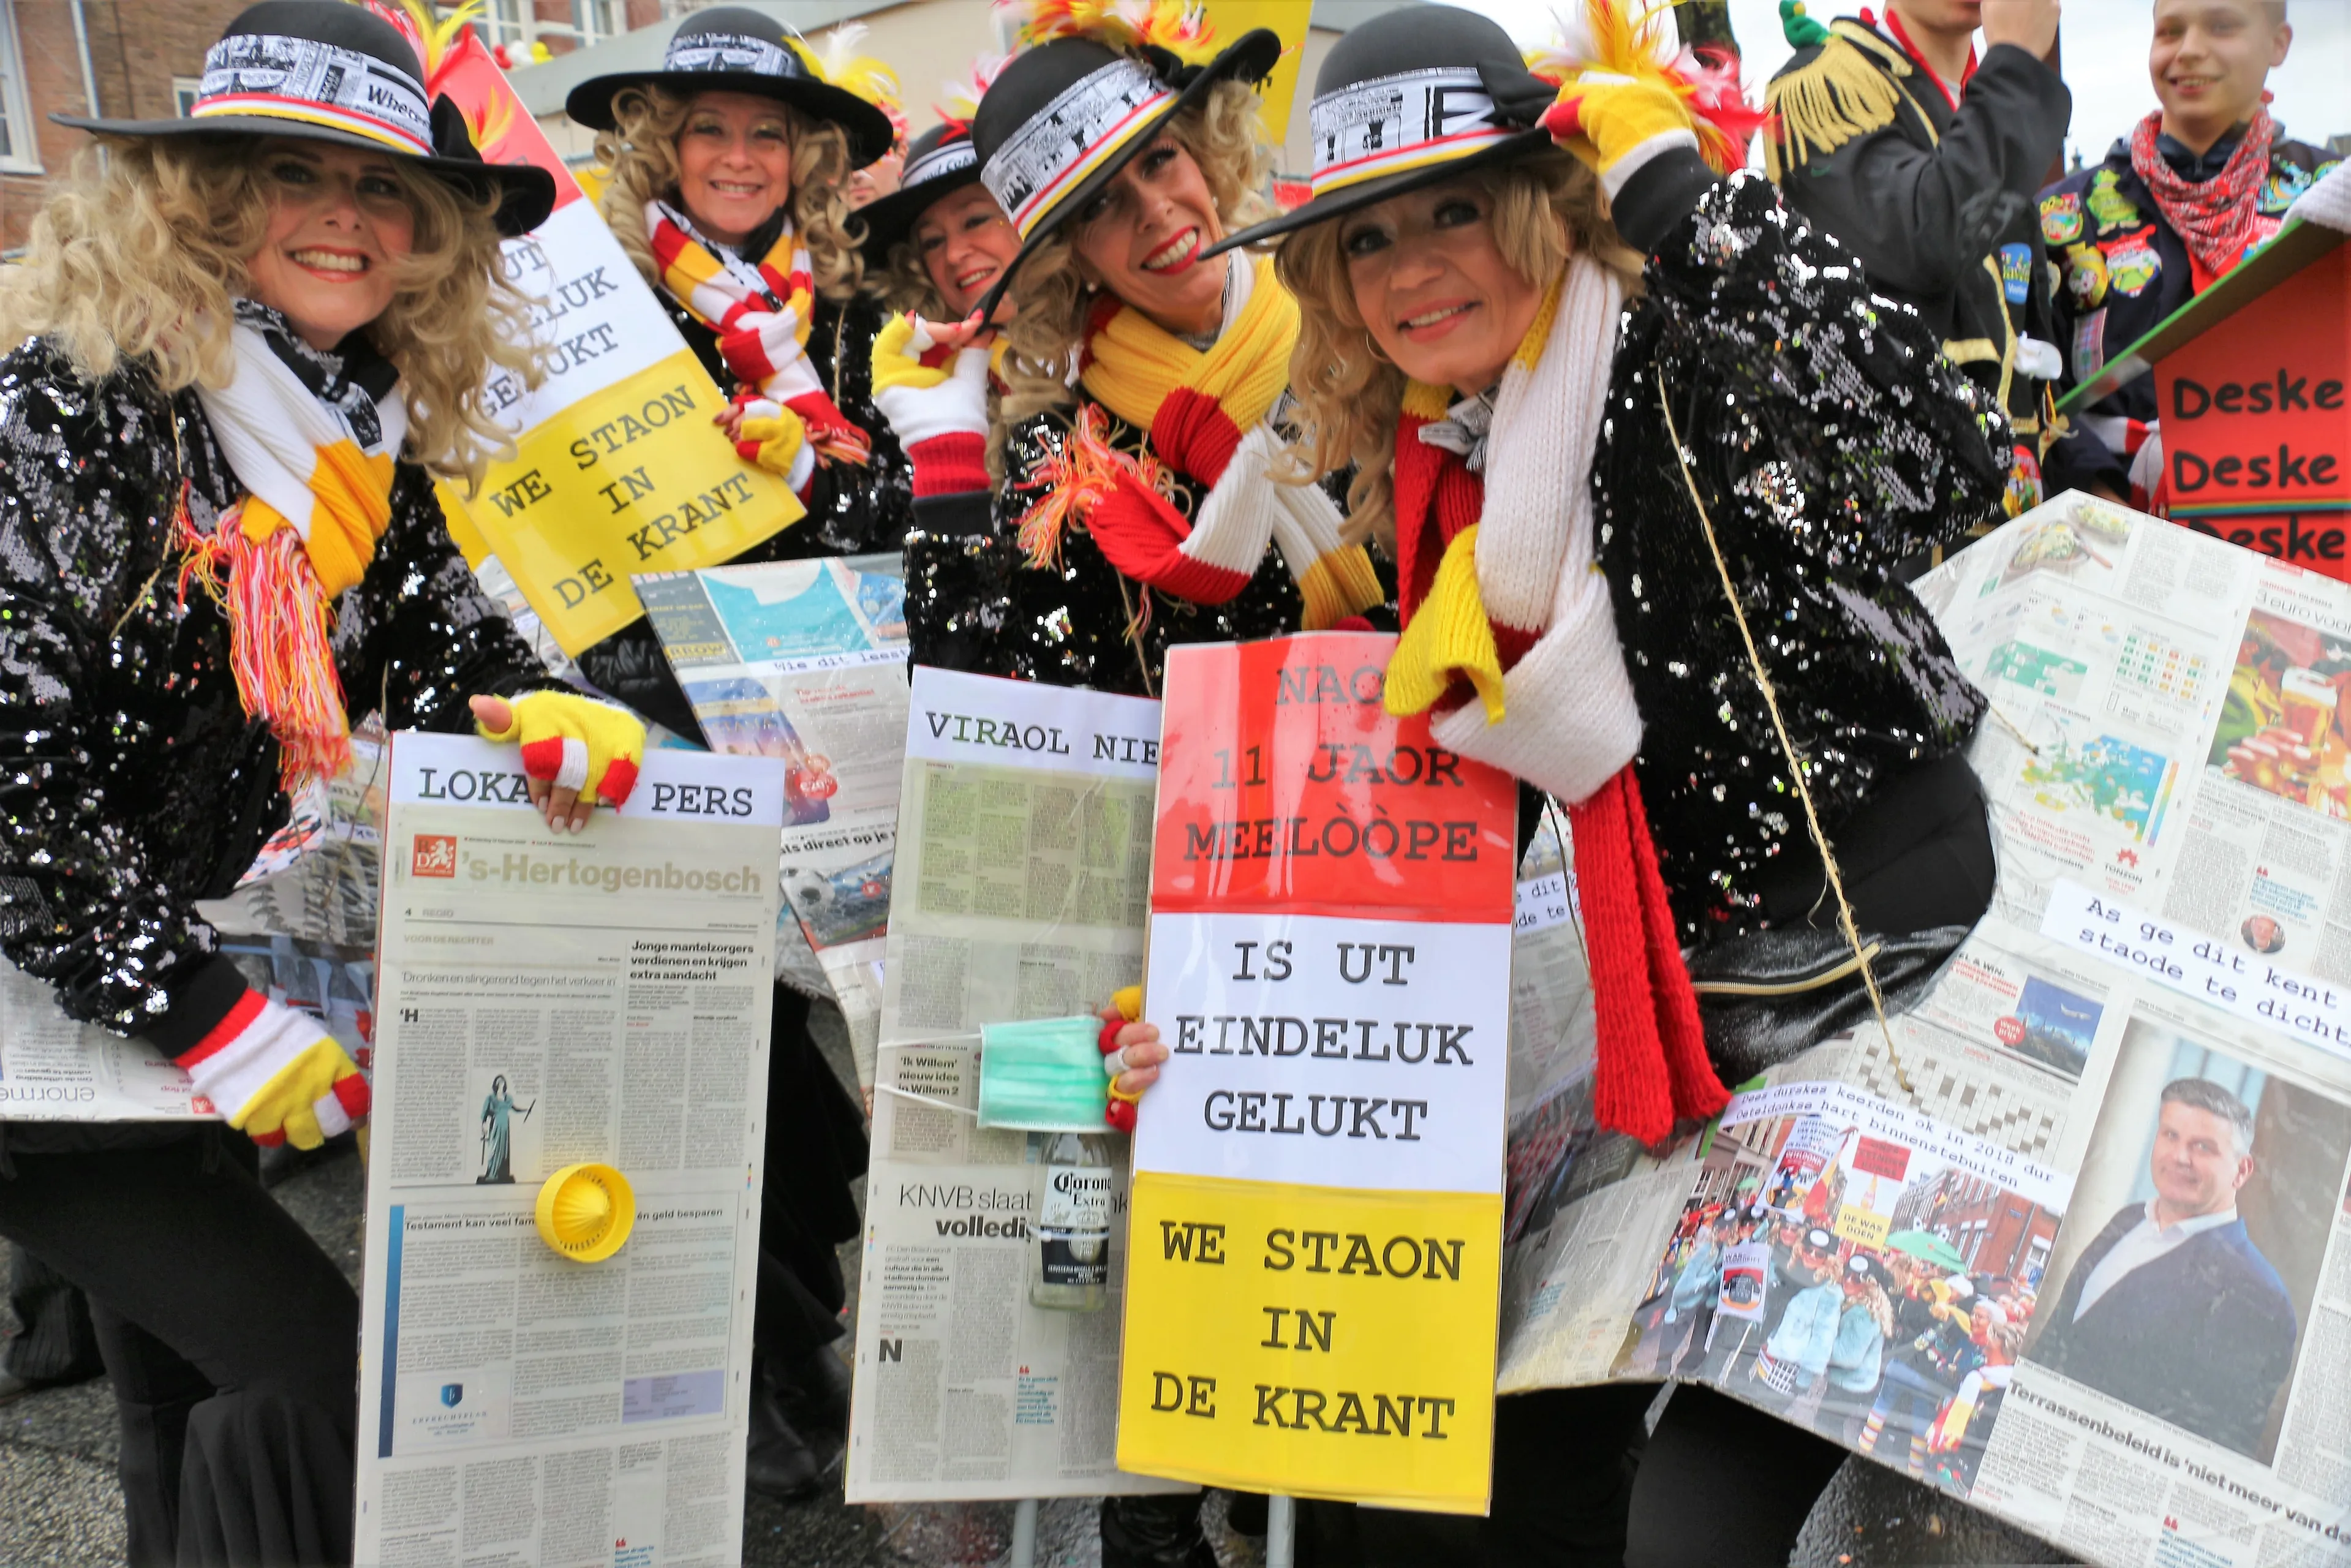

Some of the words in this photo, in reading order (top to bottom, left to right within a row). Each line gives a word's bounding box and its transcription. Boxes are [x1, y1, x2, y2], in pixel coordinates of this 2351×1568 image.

[480, 322, 619, 418] GEUKT
[2173, 369, 2344, 420] Deske
[489, 469, 553, 519] WE
[569, 384, 697, 471] STAON
[2173, 443, 2339, 491] Deske
[597, 466, 656, 514] IN
[552, 558, 615, 610] DE
[625, 472, 755, 562] KRANT
[817, 655, 850, 668] dit
[925, 710, 1070, 755] VIRAOL
[1092, 733, 1160, 764] NIE
[1211, 745, 1266, 790] 11
[1308, 743, 1465, 788] JAOR
[651, 782, 753, 816] PERS
[804, 836, 850, 850] direct
[853, 834, 872, 845] op
[874, 831, 889, 843] je
[1184, 804, 1478, 862] MEELÒÒPE
[1531, 878, 1561, 899] dit
[1547, 905, 1566, 919] te
[631, 940, 668, 954] Jonge
[670, 941, 754, 954] mantelzorgers
[631, 956, 690, 967] verdienen
[692, 957, 706, 967] en
[708, 957, 747, 969] krijgen
[1232, 940, 1292, 981] IS
[1337, 941, 1415, 986] UT
[2086, 896, 2121, 922] As
[2140, 921, 2174, 947] ge
[2192, 938, 2246, 974] dit
[2263, 965, 2338, 1010] kent
[630, 970, 661, 981] extra
[663, 970, 717, 981] aandacht
[2078, 924, 2184, 981] staode
[2205, 974, 2238, 1003] te
[2257, 997, 2351, 1049] dicht
[1174, 1014, 1474, 1066] EINDELUK
[899, 1071, 934, 1082] nieuw
[935, 1072, 960, 1082] idee
[911, 1084, 950, 1096] Willem
[951, 1085, 959, 1096] 2
[1204, 1090, 1428, 1142] GELUKT
[1837, 1085, 1905, 1122] keerden
[1915, 1119, 1935, 1134] ok
[1946, 1129, 1964, 1147] in
[1974, 1140, 2015, 1166] 2018
[2023, 1163, 2055, 1183] dur
[1820, 1099, 1860, 1122] hart
[1868, 1117, 2018, 1189] binnenstebuiten
[652, 1210, 674, 1221] geld
[677, 1208, 723, 1219] besparen
[899, 1184, 973, 1210] KNVB
[979, 1188, 1033, 1212] slaat
[1073, 1193, 1105, 1207] Extra
[406, 1220, 462, 1231] Testament
[465, 1218, 485, 1228] kan
[489, 1217, 511, 1227] veel
[514, 1217, 535, 1226] fam
[1844, 1212, 1857, 1224] DE
[1860, 1216, 1883, 1232] WAS
[1846, 1224, 1874, 1241] DOEN
[1160, 1219, 1226, 1265] WE
[1263, 1227, 1465, 1281] STAON
[878, 1338, 903, 1362] N
[1260, 1306, 1337, 1352] IN
[1150, 1371, 1217, 1419] DE
[1252, 1384, 1455, 1439] KRANT
[2008, 1379, 2162, 1462] Terrassenbeleid
[2164, 1450, 2181, 1469] is
[2227, 1478, 2283, 1514] meer
[2285, 1506, 2322, 1534] van
